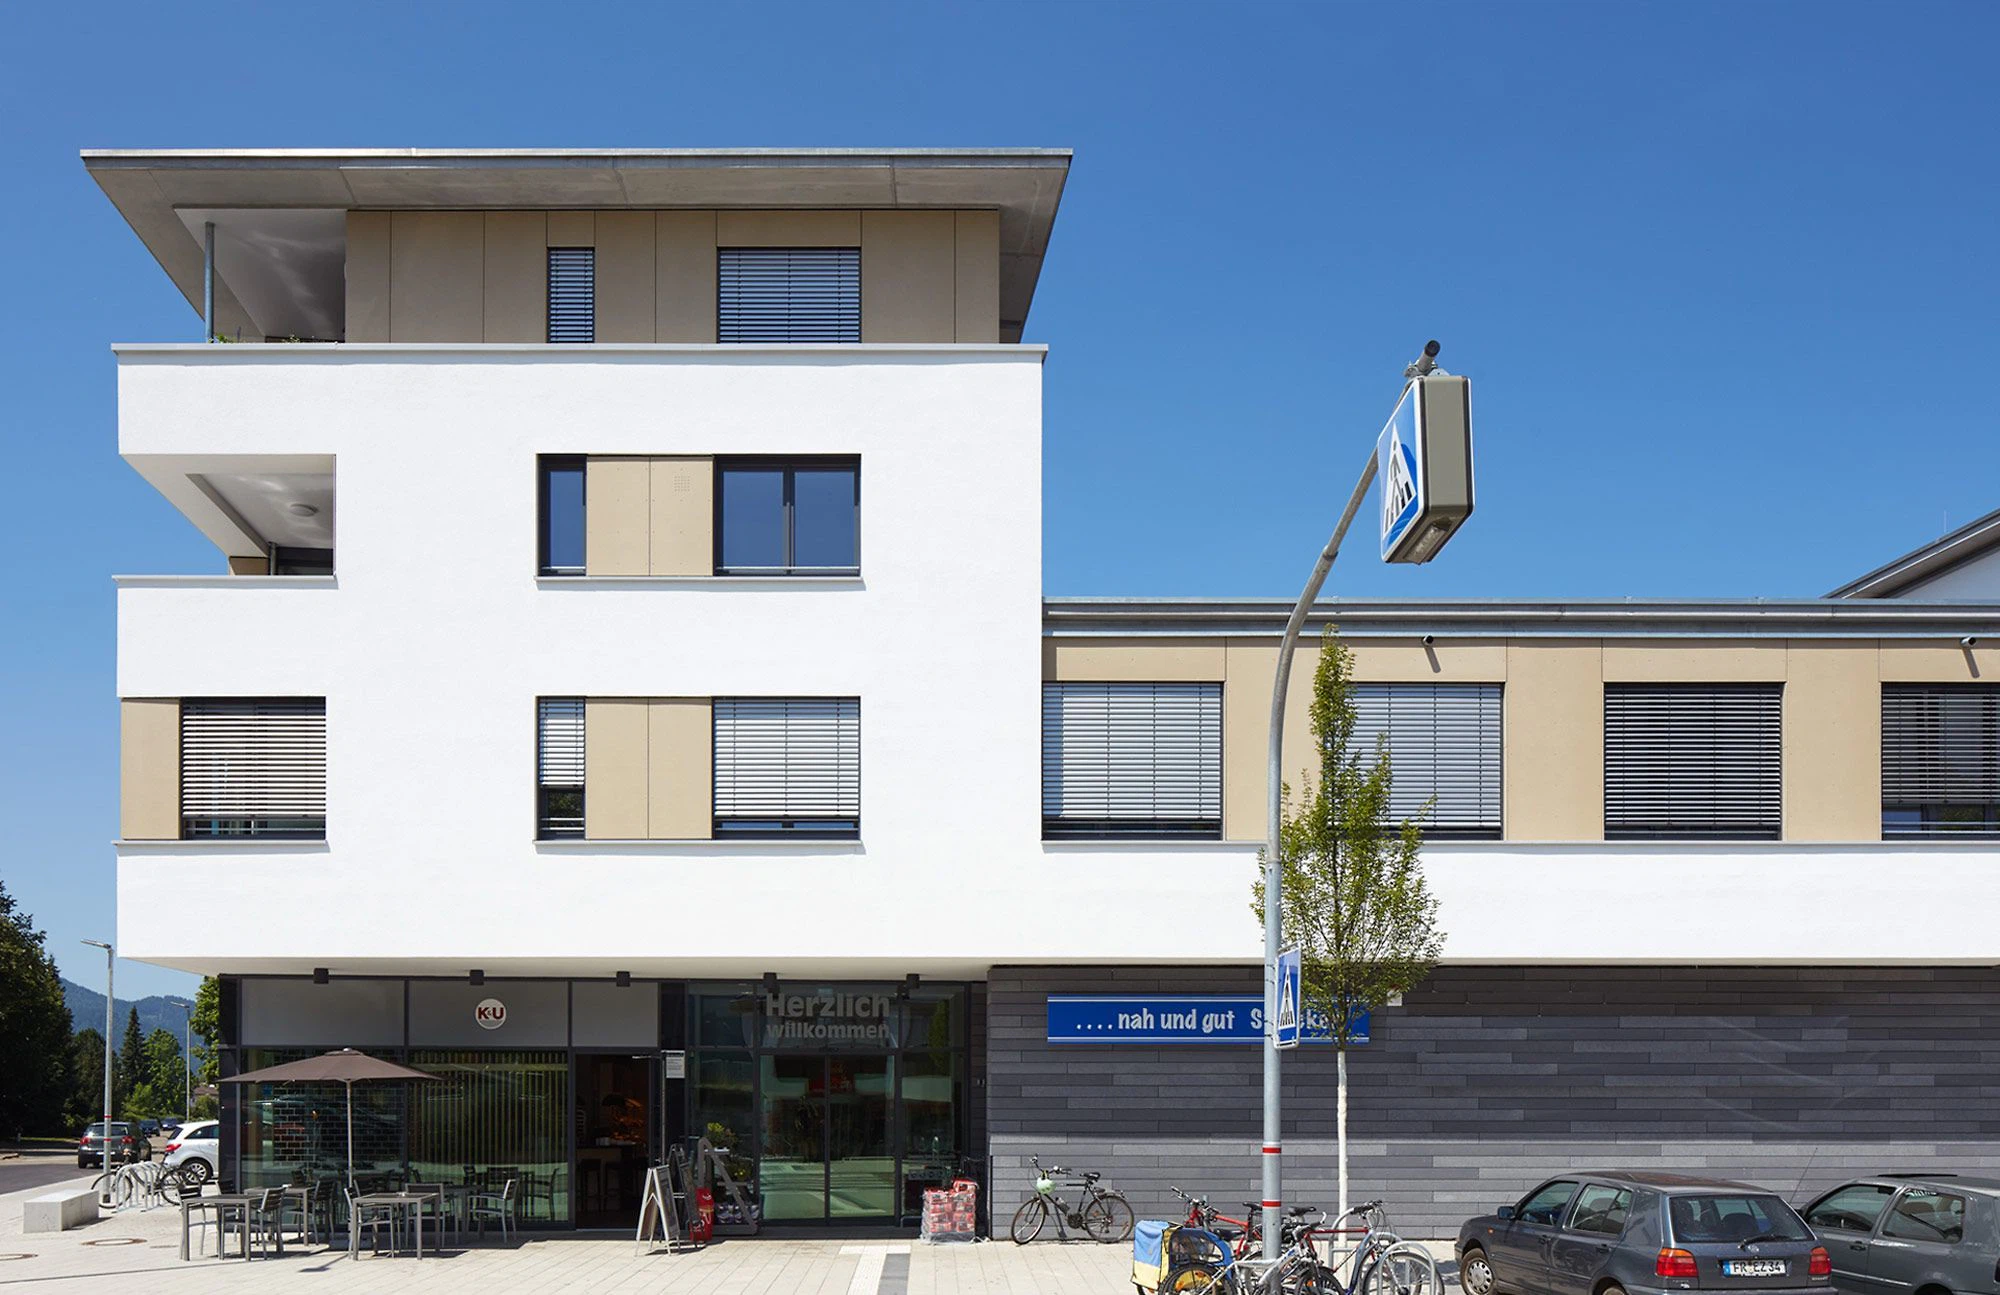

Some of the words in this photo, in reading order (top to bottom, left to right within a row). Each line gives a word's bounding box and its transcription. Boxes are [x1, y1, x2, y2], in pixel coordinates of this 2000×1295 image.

[766, 992, 890, 1017] Herzlich
[766, 1021, 891, 1039] willkommen
[1160, 1008, 1197, 1030] und
[1202, 1010, 1236, 1034] gut
[1733, 1261, 1748, 1273] FR
